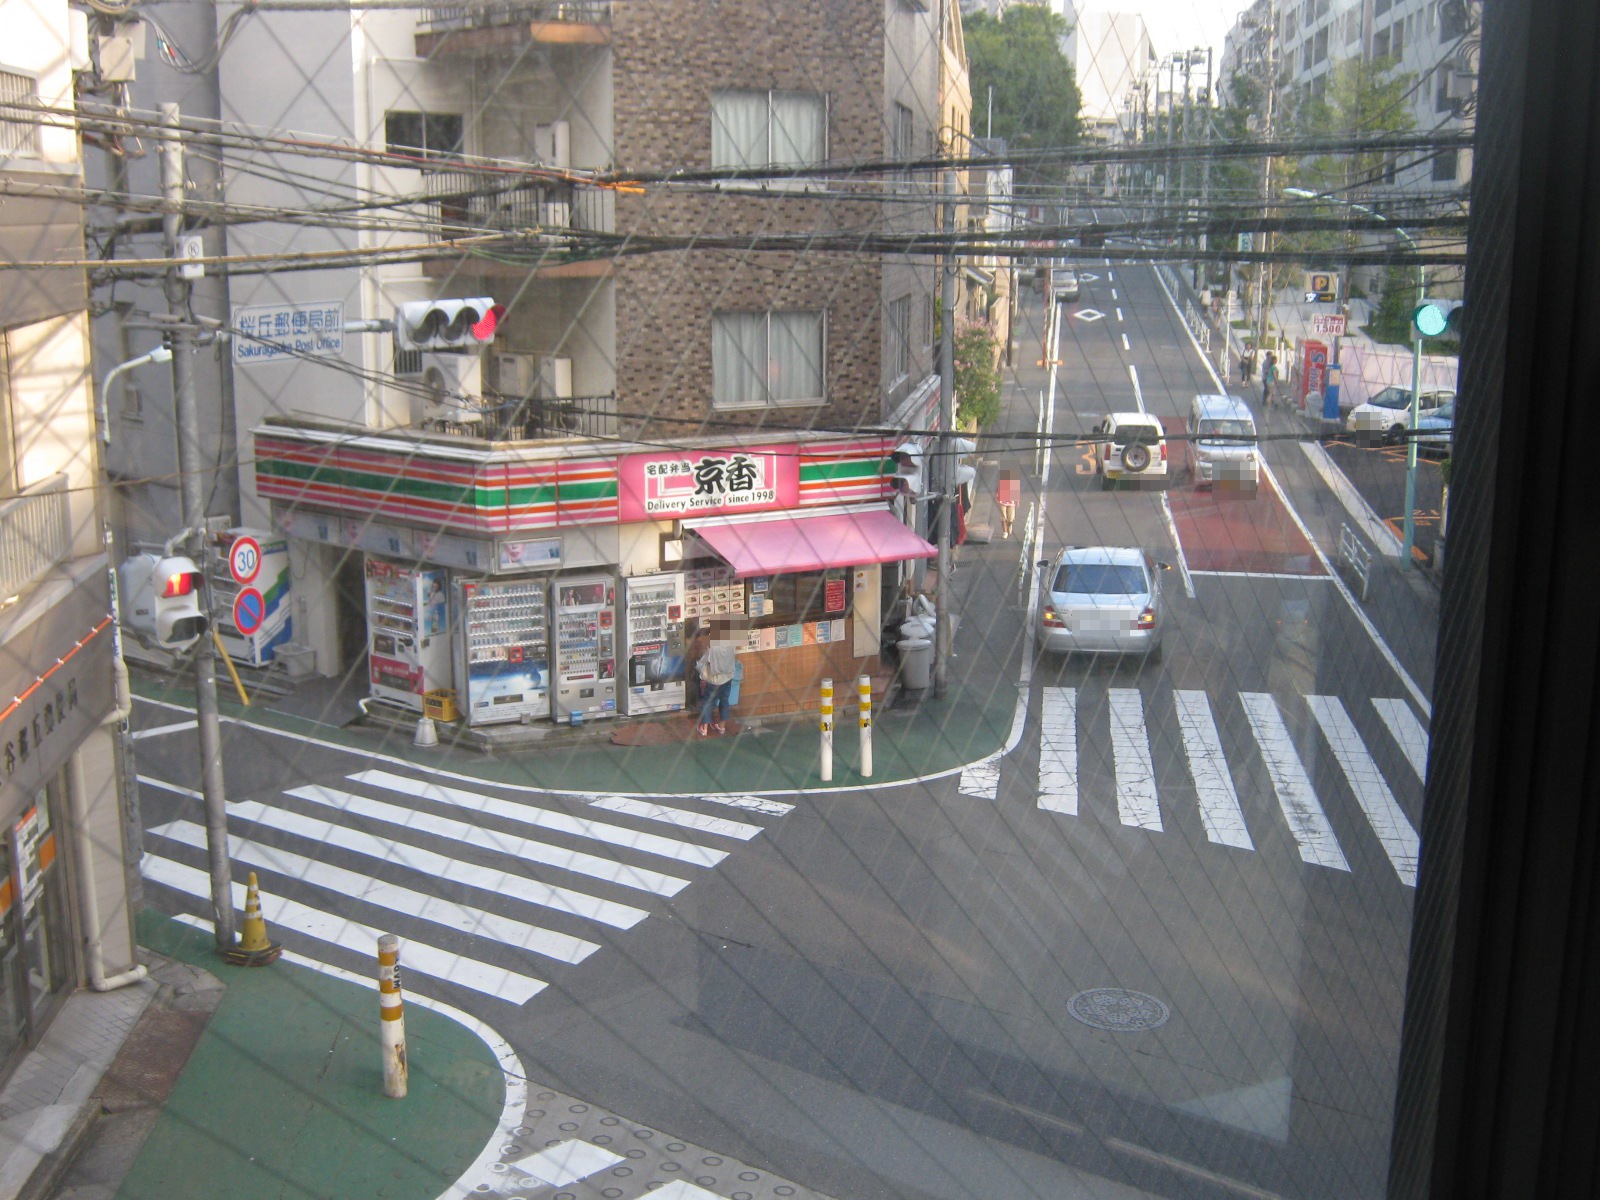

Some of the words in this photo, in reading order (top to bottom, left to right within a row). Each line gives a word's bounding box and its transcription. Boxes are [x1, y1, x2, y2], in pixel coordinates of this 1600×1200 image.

[240, 308, 339, 338] 桜丘郵便局前
[238, 341, 293, 357] Sakuragaoka
[295, 339, 313, 351] Post
[317, 337, 339, 350] Office
[646, 463, 691, 475] 宅配弁当
[694, 456, 757, 495] 京香
[647, 499, 686, 511] Delivery
[689, 496, 722, 507] Service
[728, 494, 750, 503] since
[752, 490, 774, 501] 1998
[237, 549, 255, 572] 30
